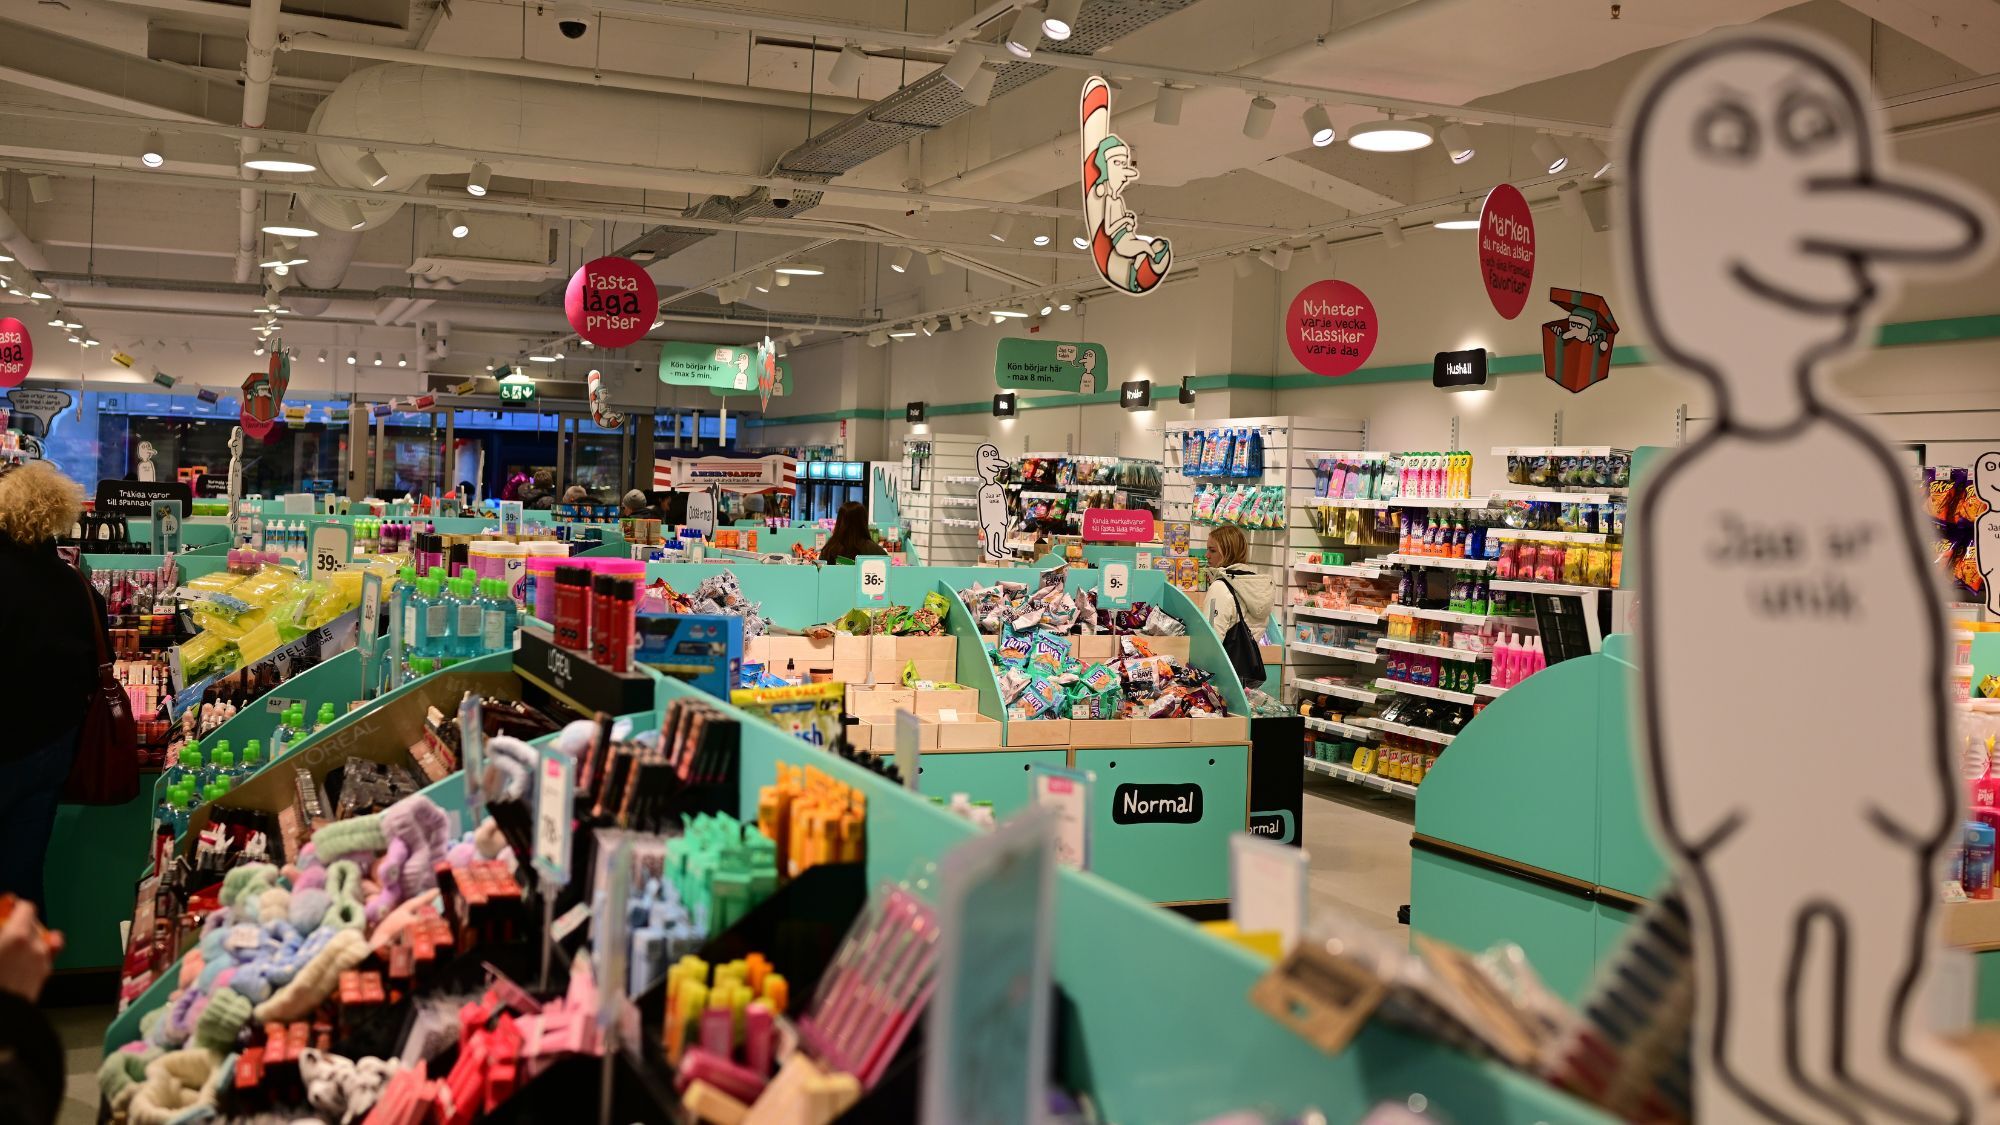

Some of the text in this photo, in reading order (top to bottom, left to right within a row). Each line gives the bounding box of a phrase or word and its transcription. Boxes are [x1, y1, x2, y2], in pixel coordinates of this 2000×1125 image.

[1488, 210, 1530, 244] Märken
[1482, 234, 1491, 251] du
[1492, 240, 1511, 257] redan
[588, 272, 639, 292] Fasta
[582, 285, 641, 316] låga
[1303, 299, 1364, 318] Nyheter
[586, 314, 640, 332] priser
[1301, 318, 1366, 330] varje vecka
[0, 331, 22, 344] asta
[1300, 327, 1365, 344] Klassiker
[0, 344, 23, 363] ga
[1306, 344, 1359, 357] varje dag
[0, 361, 24, 374] riser
[670, 361, 720, 372] Kön börjar här
[1007, 362, 1063, 373] Kön börjar här
[1446, 361, 1472, 375] Hushåll
[1030, 374, 1035, 382] 8
[1037, 375, 1055, 383] min.
[1987, 523, 2000, 531] Ja
[316, 553, 342, 572] 39:-
[864, 574, 884, 586] 36:-
[1110, 578, 1123, 589] 9:-
[250, 627, 332, 676] MAYBELLINE
[1131, 670, 1153, 680] CRAVE
[792, 722, 824, 746] ish
[1123, 789, 1194, 815] Normal
[1250, 819, 1280, 834] ormal
